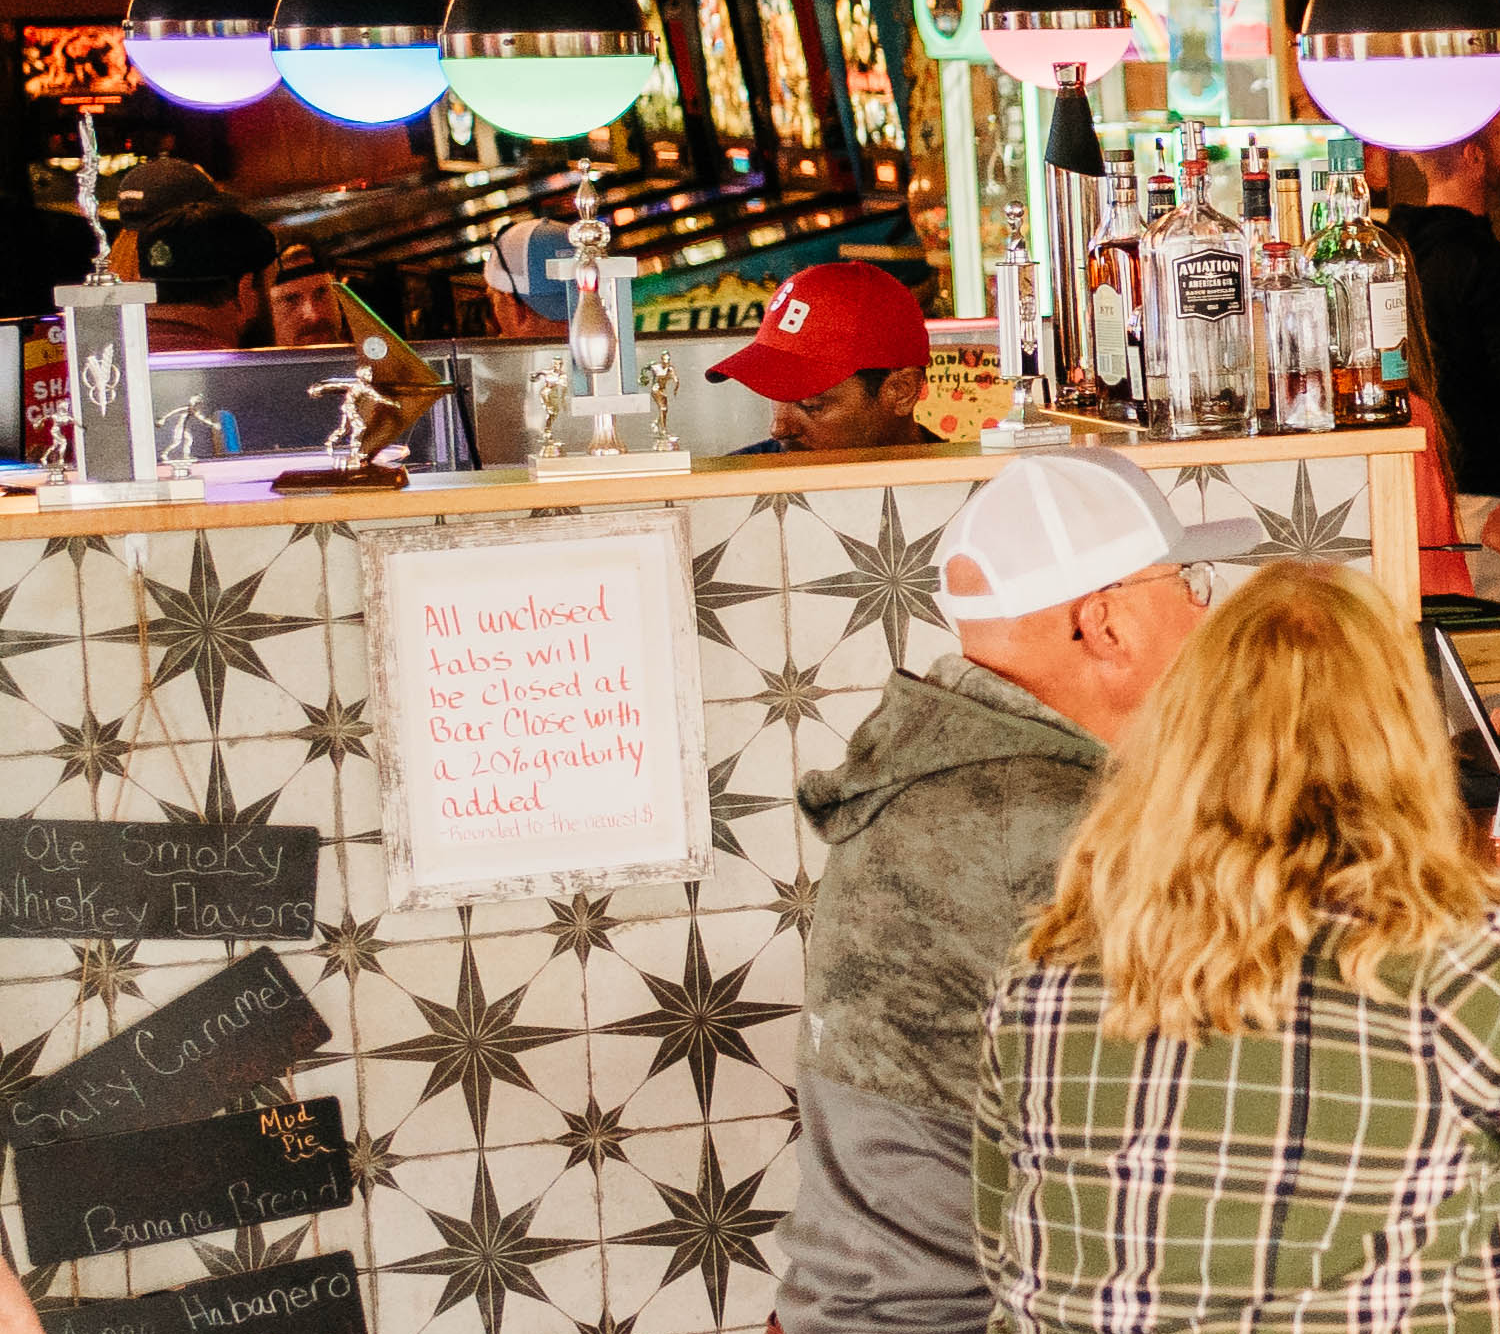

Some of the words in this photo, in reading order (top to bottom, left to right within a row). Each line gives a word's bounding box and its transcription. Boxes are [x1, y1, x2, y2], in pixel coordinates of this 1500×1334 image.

[1178, 258, 1240, 276] AVIATION
[926, 372, 960, 389] erry
[424, 604, 461, 637] All
[477, 584, 613, 634] unclosed
[428, 647, 512, 676] tabs
[526, 633, 591, 668] will
[430, 686, 464, 710] be
[595, 665, 634, 694] at
[429, 715, 494, 744] Bar
[503, 706, 577, 738] Close
[584, 700, 641, 730] with
[433, 758, 461, 781] a
[441, 779, 550, 819] added
[260, 1103, 316, 1136] Mud
[282, 1132, 322, 1156] Pie
